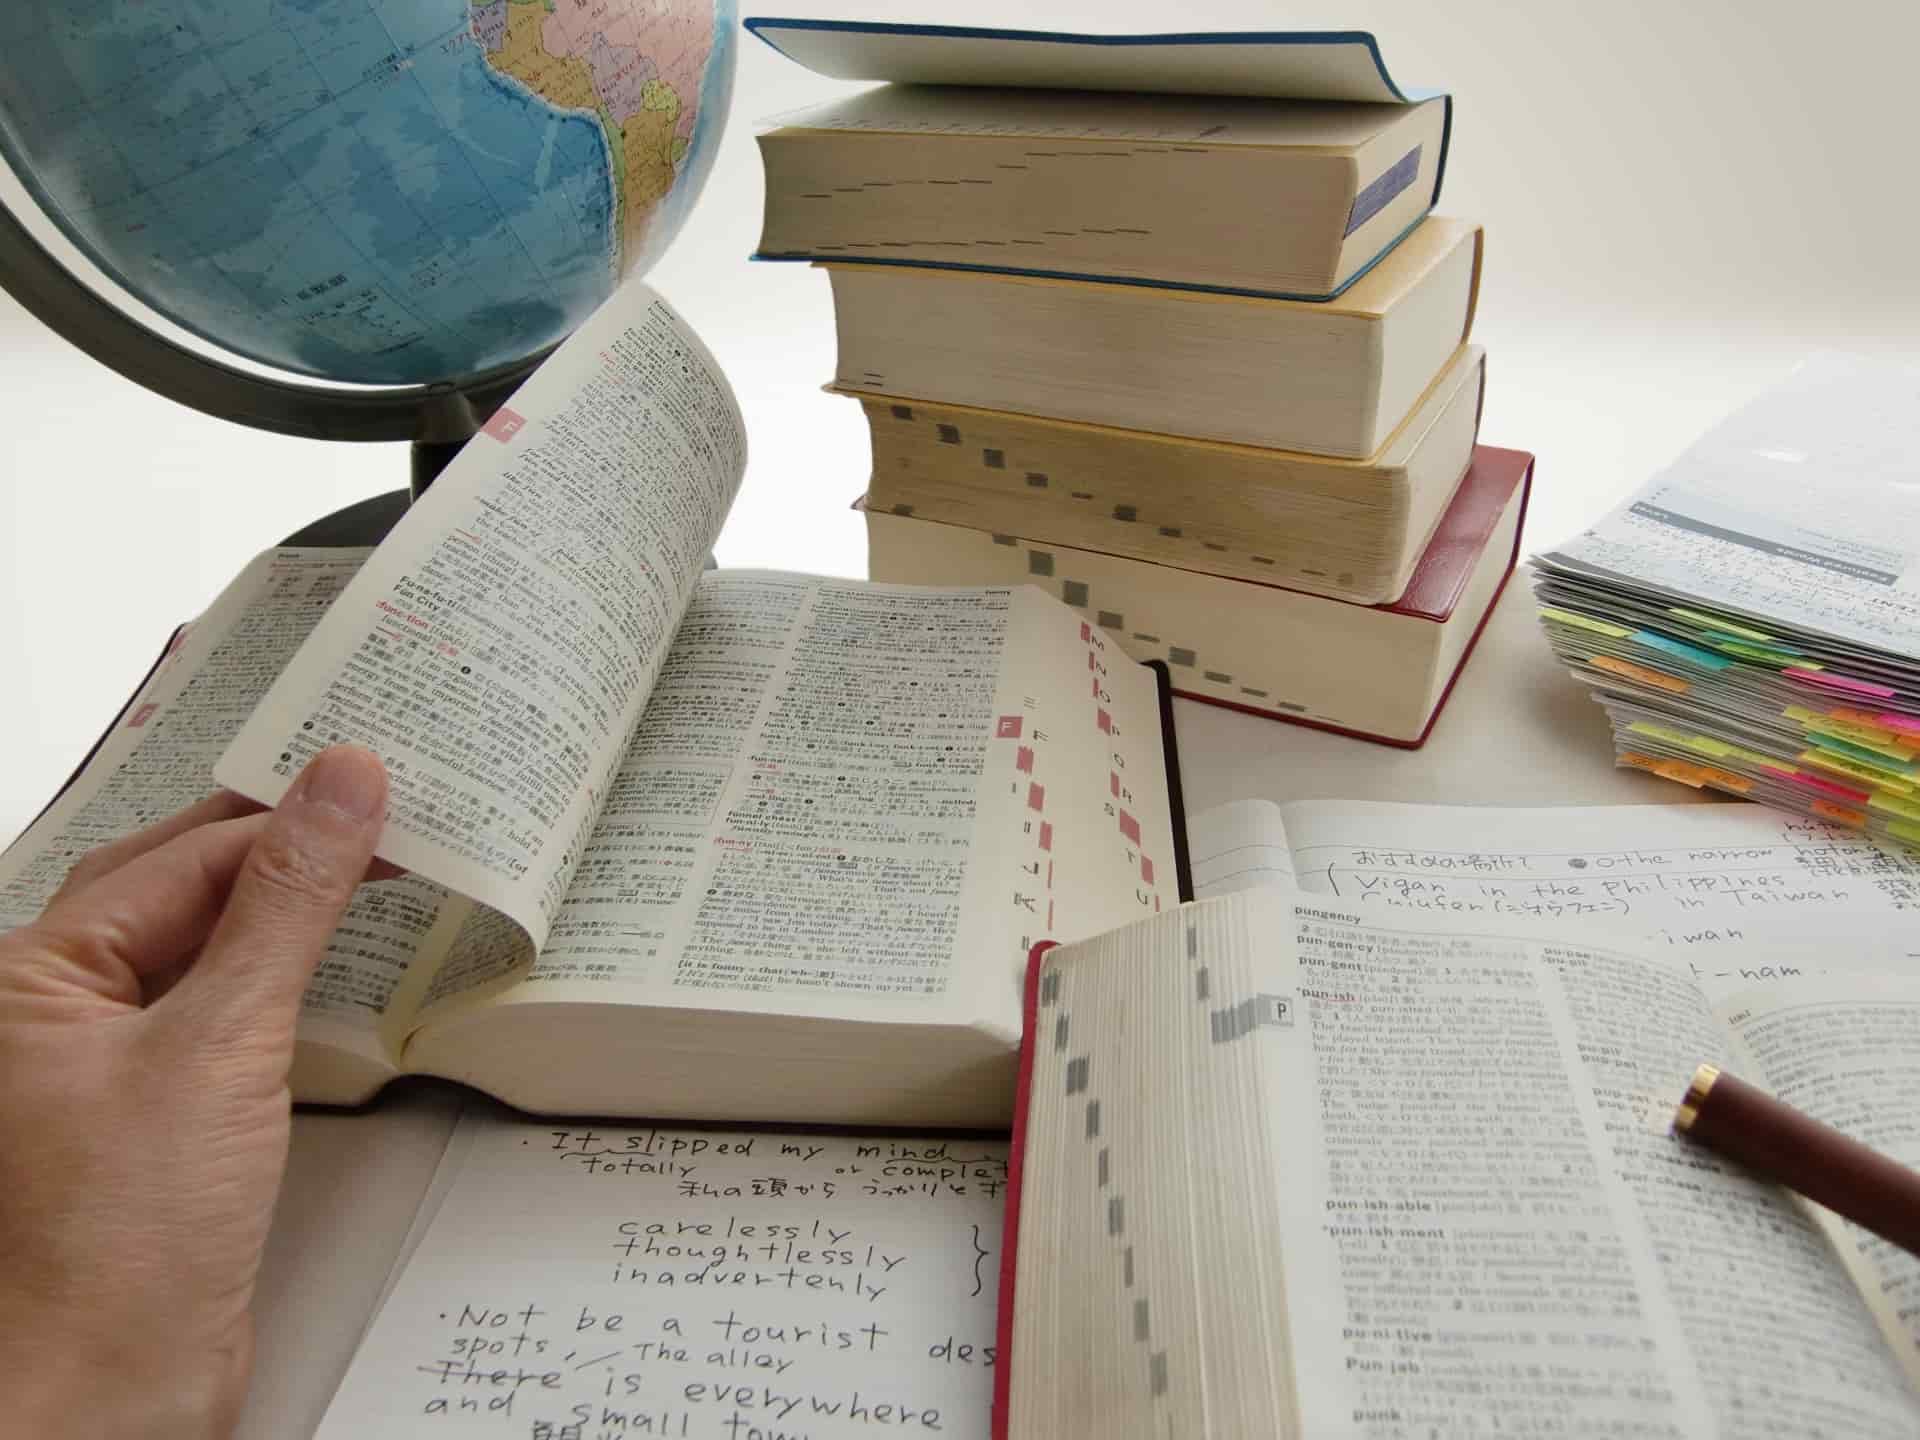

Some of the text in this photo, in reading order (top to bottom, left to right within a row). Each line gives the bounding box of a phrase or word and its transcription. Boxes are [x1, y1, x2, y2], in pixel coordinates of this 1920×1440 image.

[1354, 873, 1785, 898] Vigan in the Philippines
[1719, 888, 1849, 907] Taiwan
[1295, 906, 1361, 925] pungency
[552, 1128, 952, 1161] It slipped my mind
[580, 1156, 697, 1178] totally
[618, 1217, 851, 1245] carelessly
[613, 1236, 906, 1272] thoughtlessly
[613, 1262, 887, 1302] inadvertenly
[457, 1304, 998, 1368] Not be a tourist des
[632, 1343, 690, 1362] The
[706, 1348, 794, 1374] alley
[424, 1390, 516, 1418] and
[571, 1402, 690, 1438] small
[605, 1366, 642, 1396] is
[683, 1382, 943, 1431] everywhere
